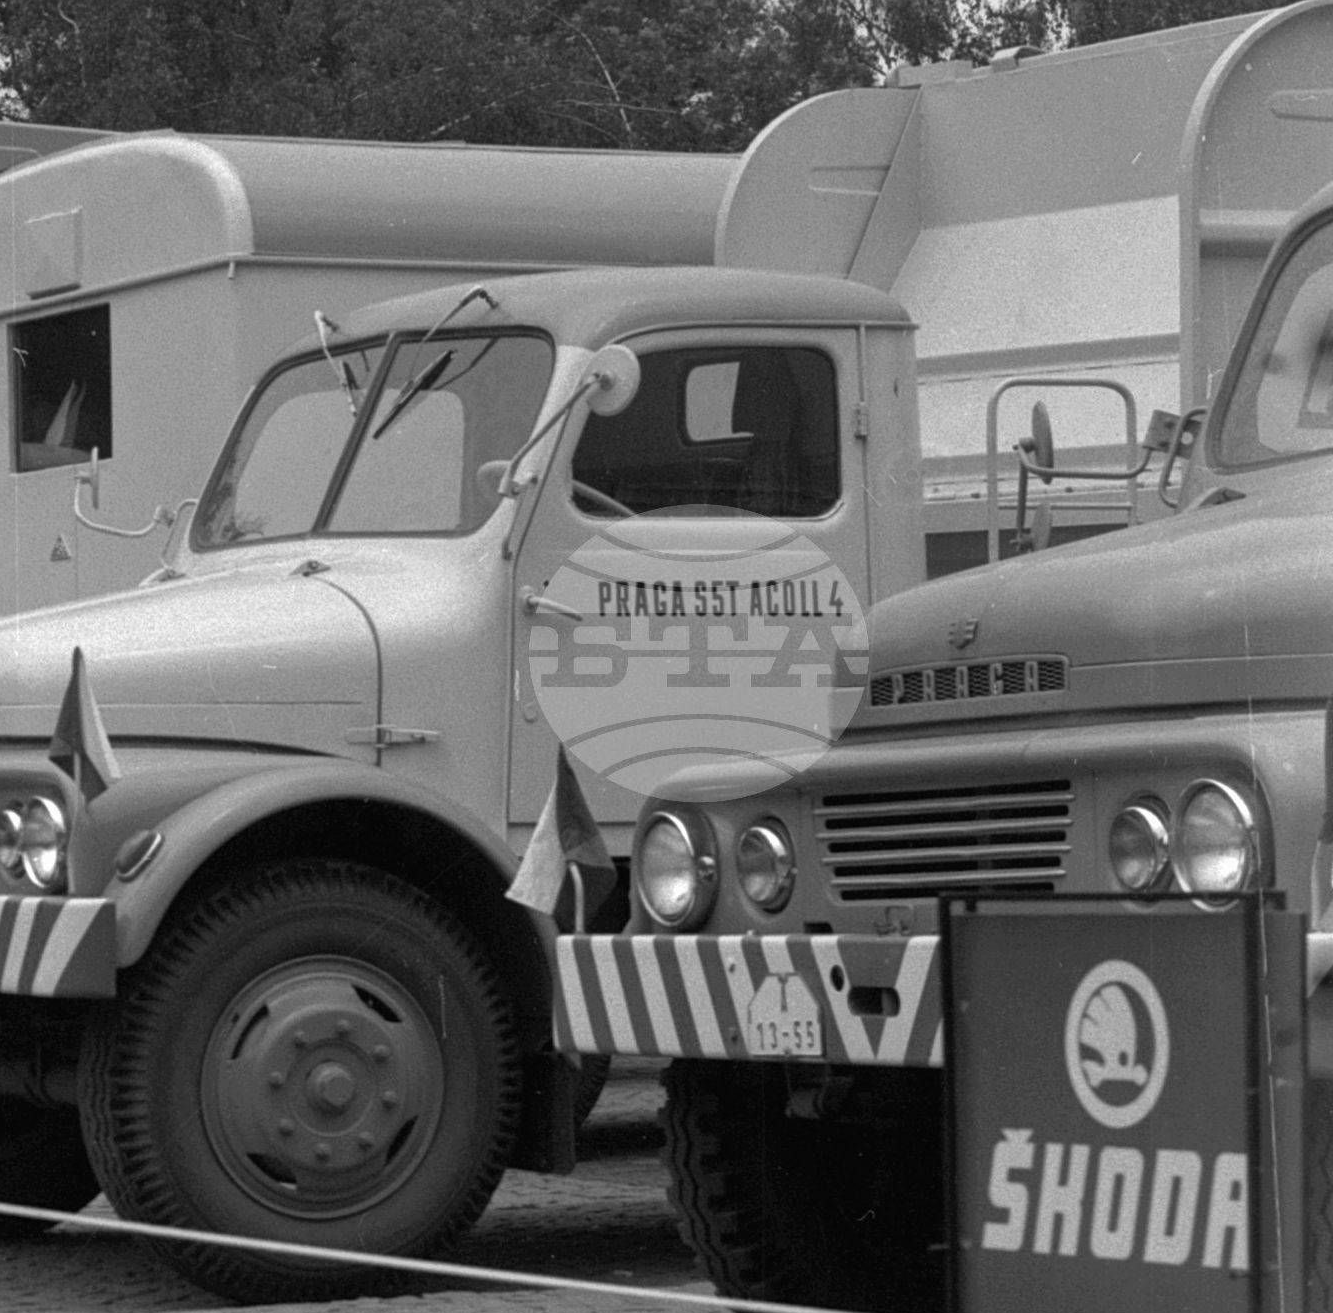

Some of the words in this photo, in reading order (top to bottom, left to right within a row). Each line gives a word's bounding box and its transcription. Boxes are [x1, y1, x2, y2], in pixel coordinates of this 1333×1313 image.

[598, 580, 686, 617] PRAGA
[829, 580, 844, 617] 4
[891, 661, 1039, 705] PRAGA
[756, 1020, 815, 1050] 13-55
[981, 1128, 1250, 1271] ŠKODA
